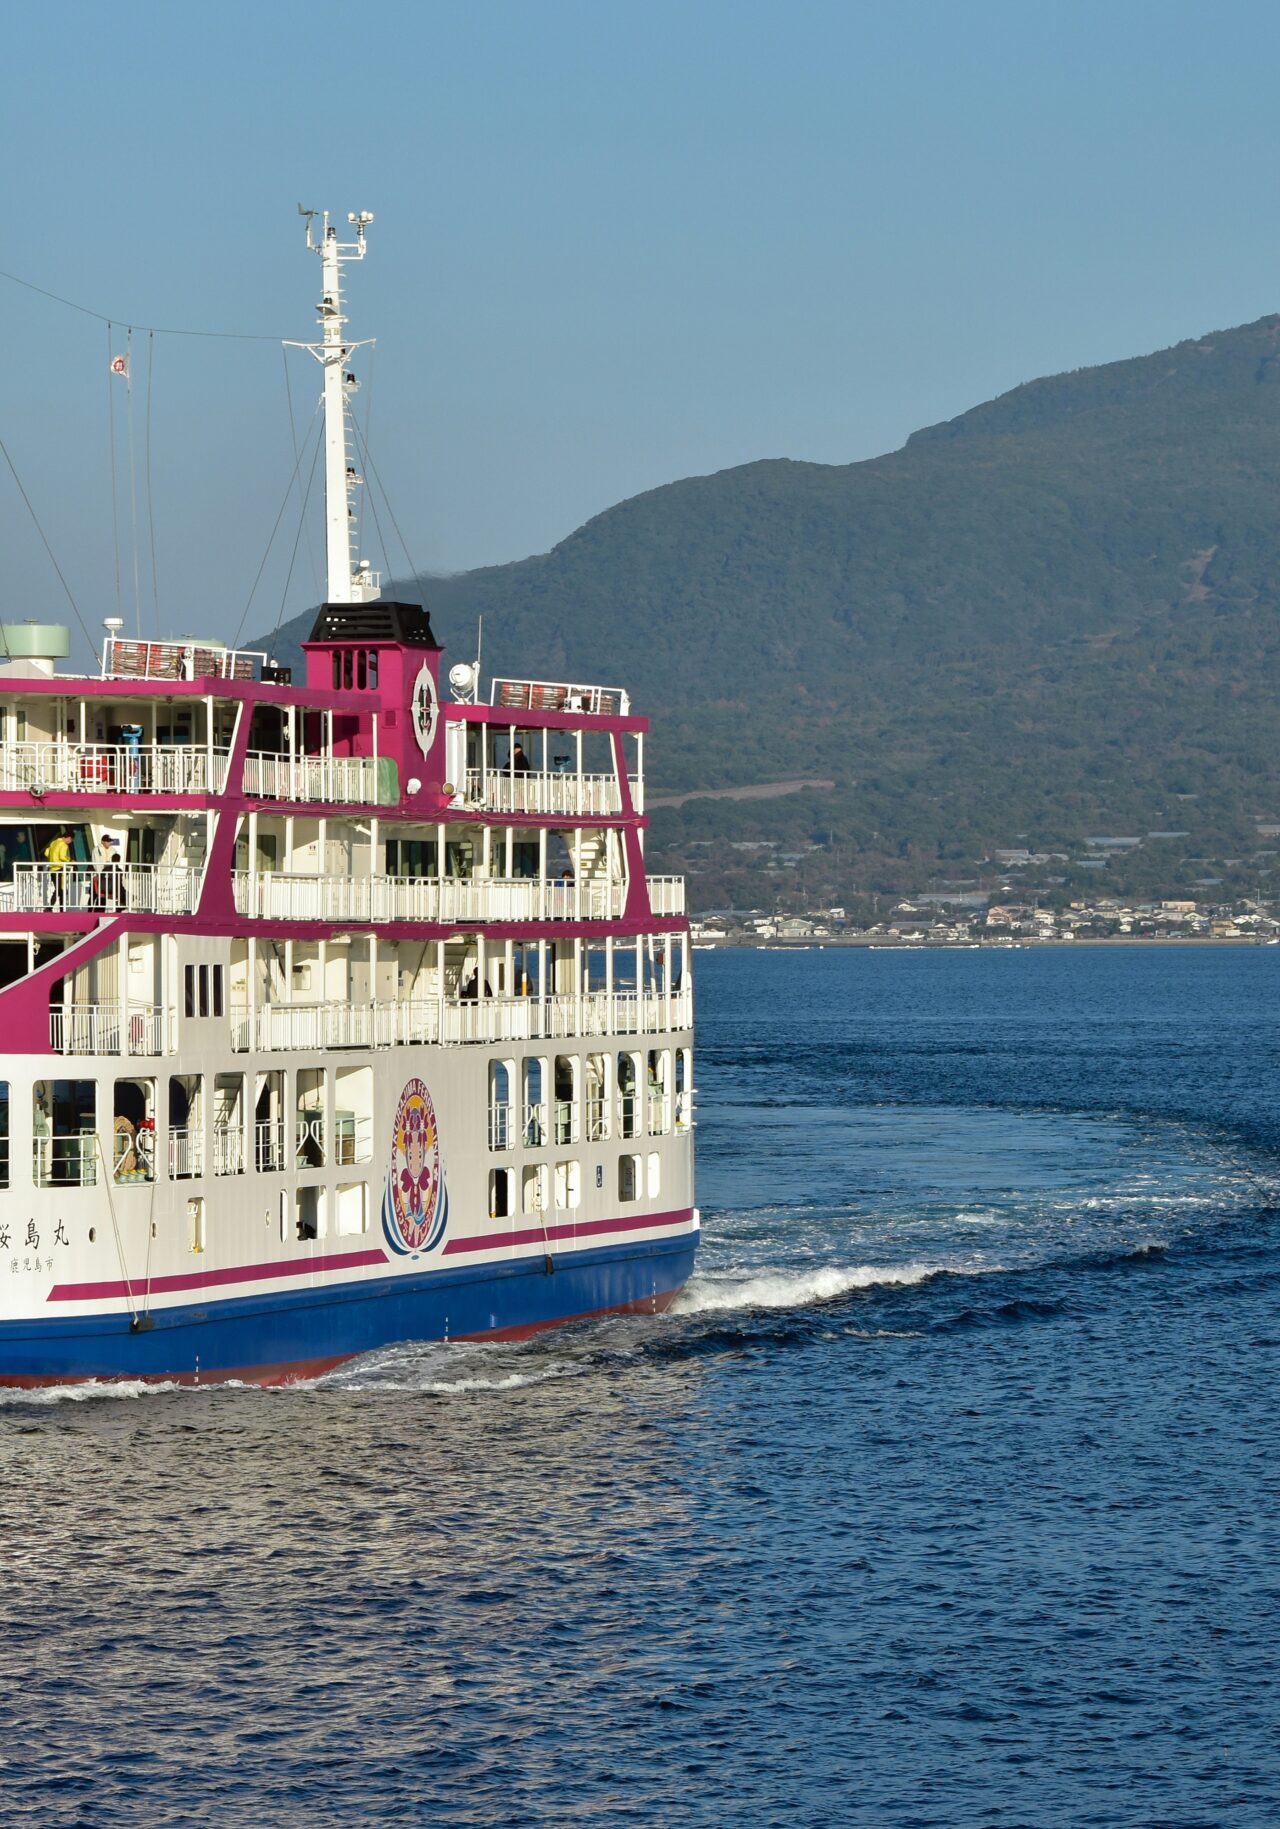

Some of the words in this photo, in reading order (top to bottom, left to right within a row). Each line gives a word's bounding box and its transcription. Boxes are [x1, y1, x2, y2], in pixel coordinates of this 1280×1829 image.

[391, 1080, 417, 1169] AKURAJIMA
[9, 1256, 54, 1274] 鹿児島市
